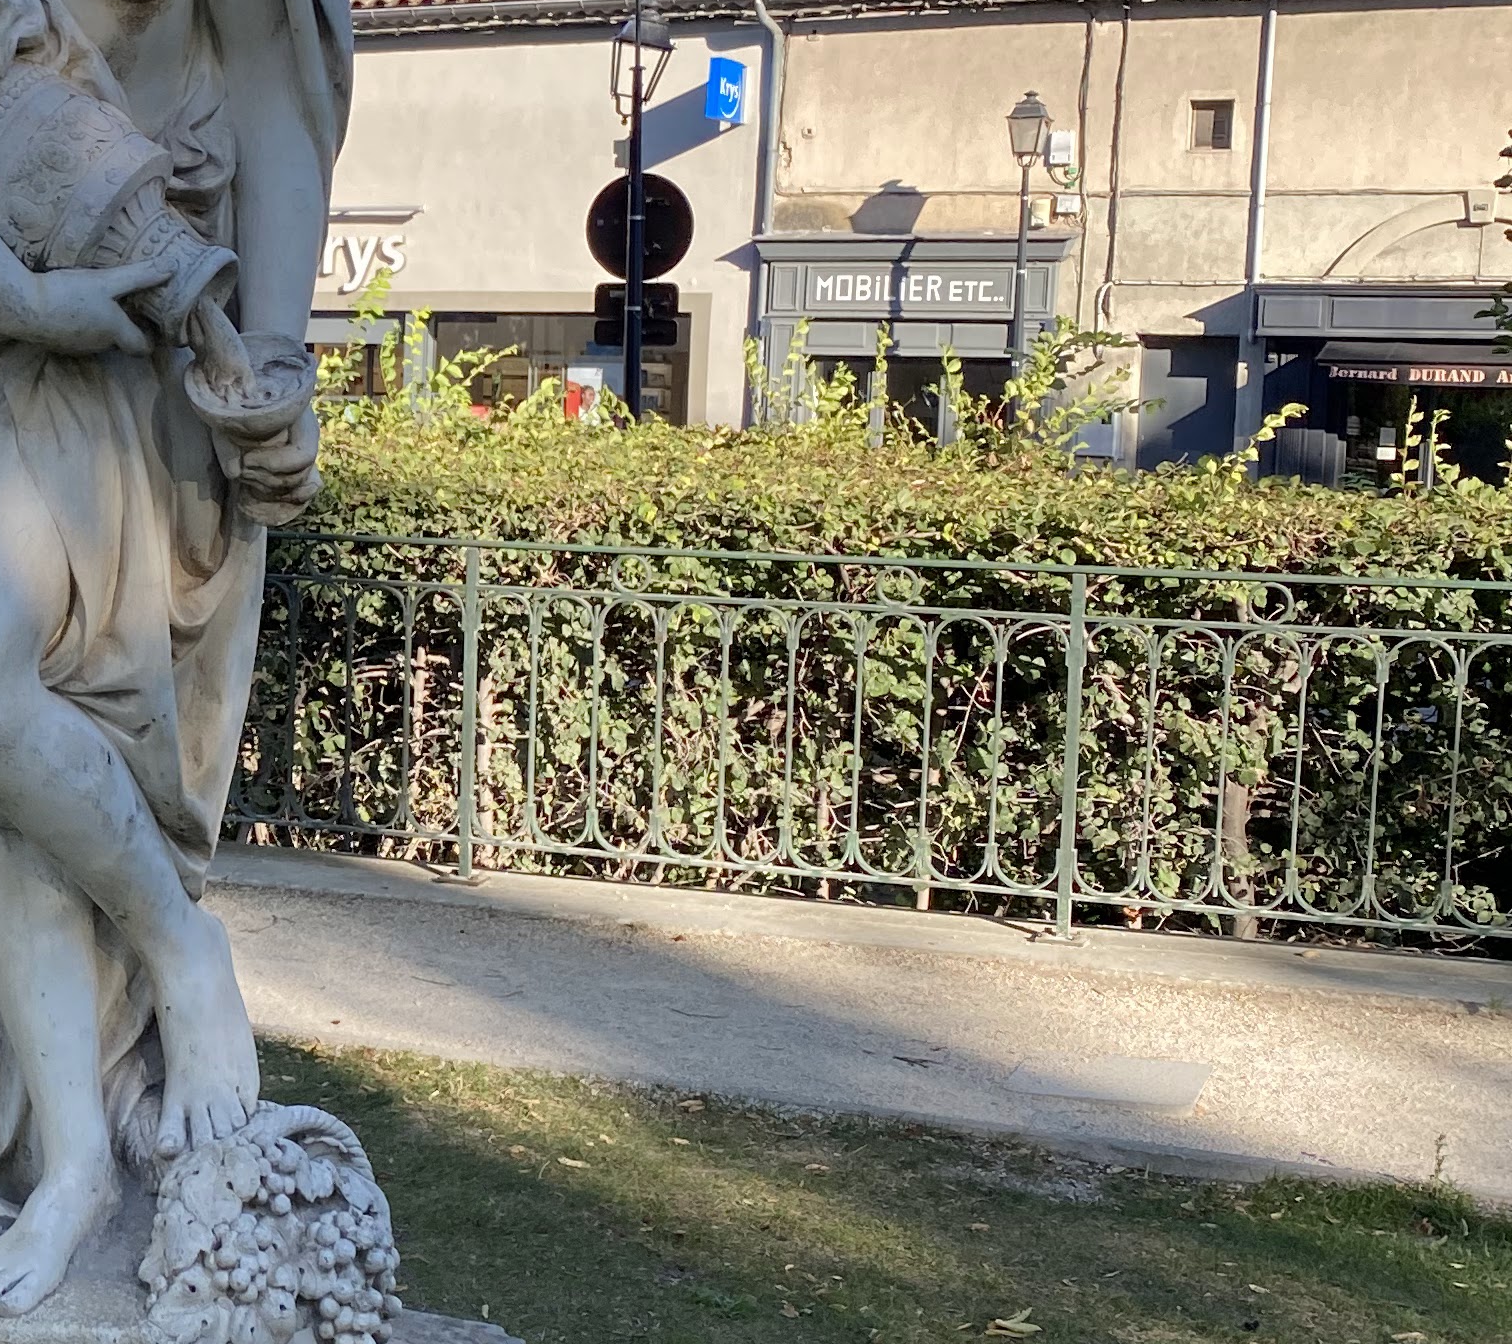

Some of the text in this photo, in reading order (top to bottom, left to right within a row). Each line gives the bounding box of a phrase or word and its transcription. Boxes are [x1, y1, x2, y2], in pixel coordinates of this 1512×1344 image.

[719, 76, 739, 103] Krys
[322, 234, 406, 292] rys
[1408, 367, 1487, 383] DURAND
[1496, 369, 1512, 384] A
